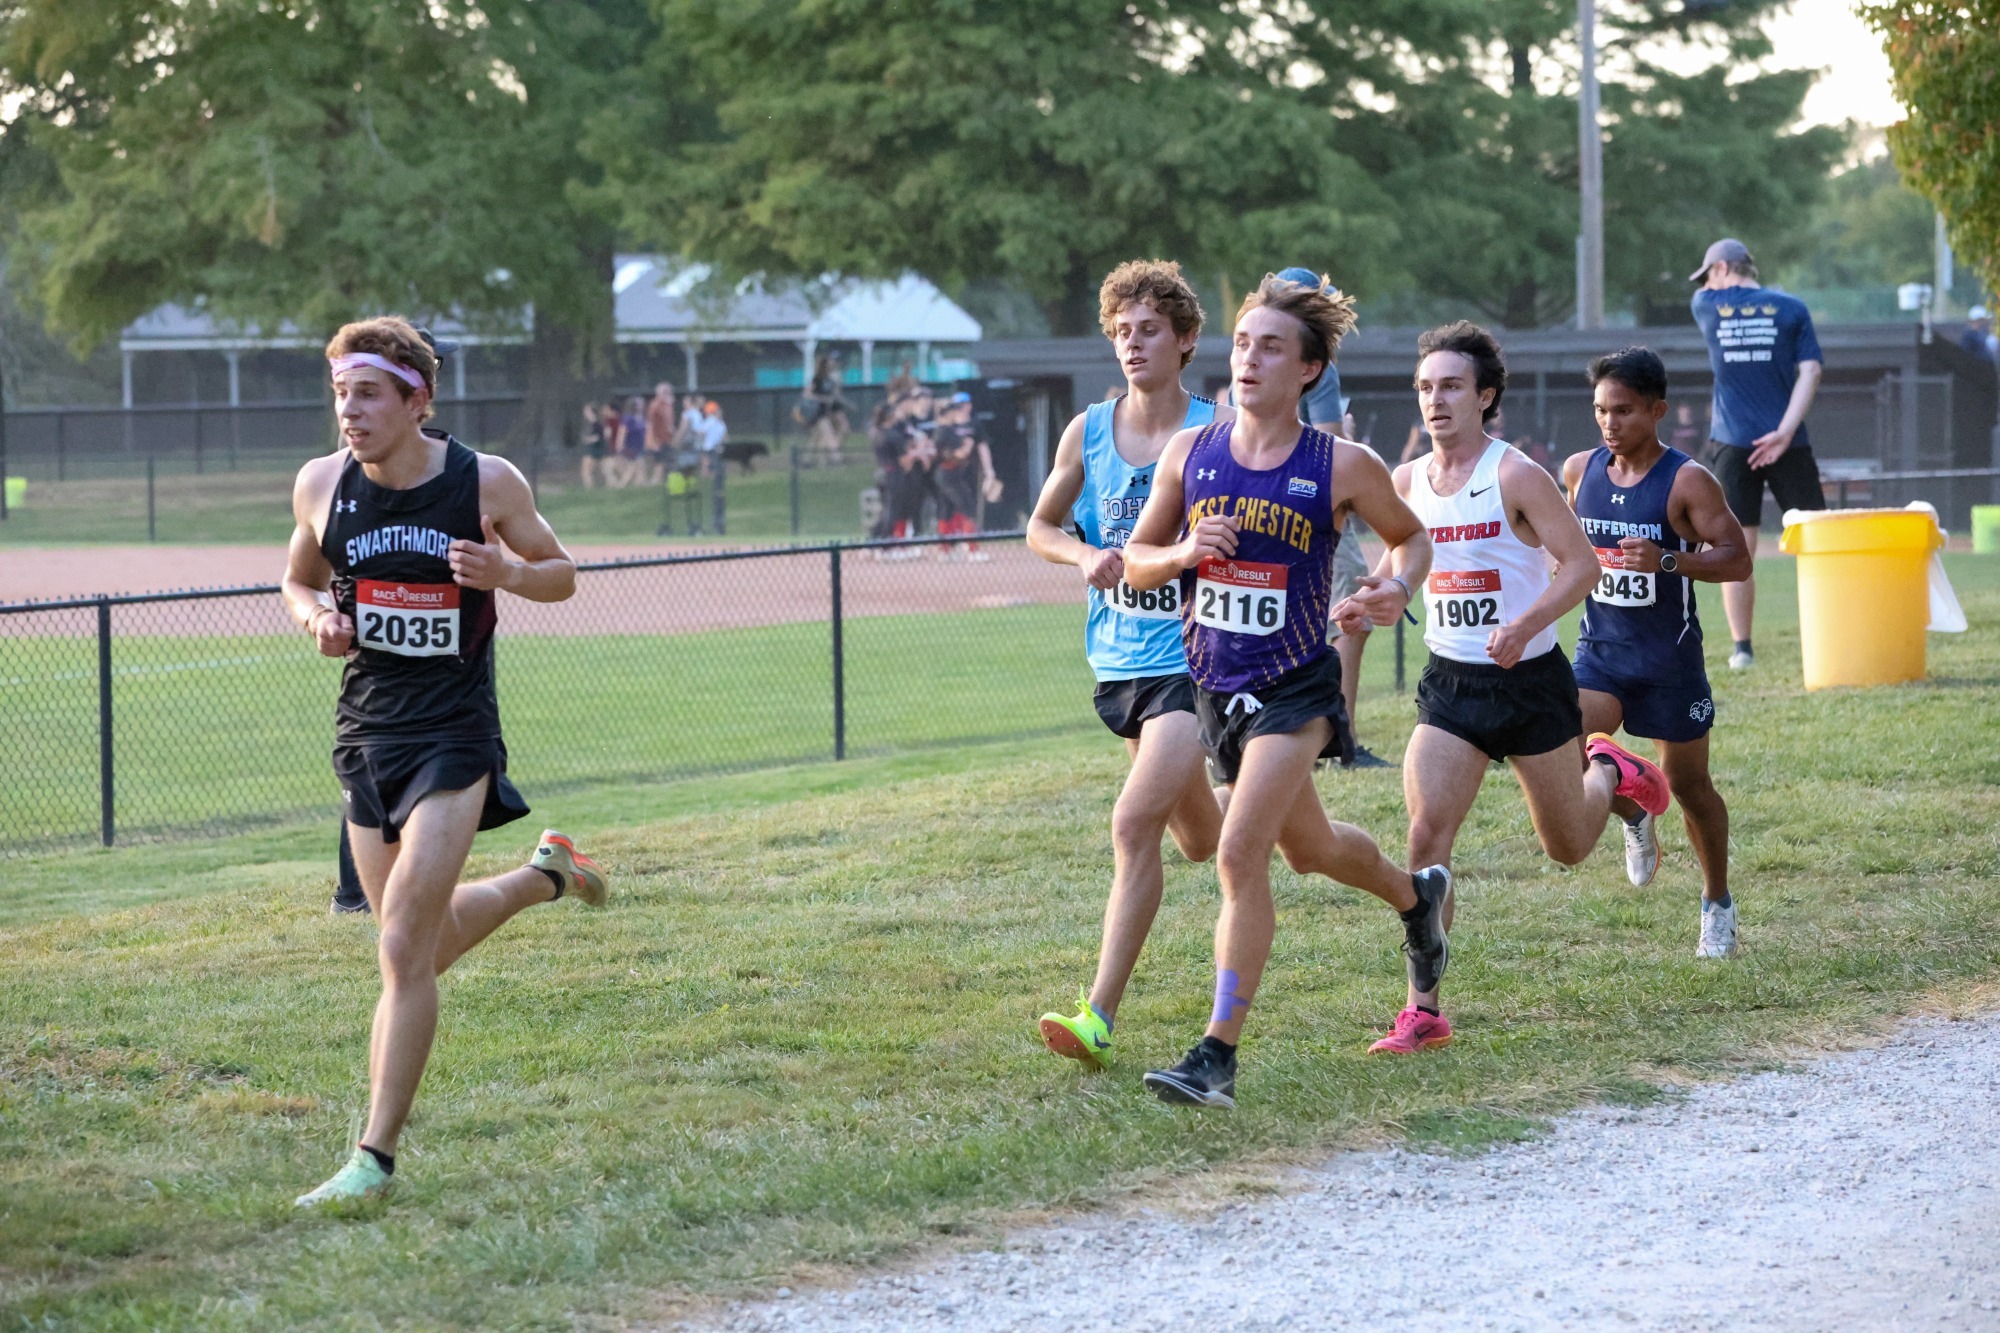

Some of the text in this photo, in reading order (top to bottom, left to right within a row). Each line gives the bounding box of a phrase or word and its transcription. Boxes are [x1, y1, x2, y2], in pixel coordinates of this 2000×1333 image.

[1290, 482, 1317, 494] PSAC
[1103, 496, 1149, 520] JOH
[1234, 497, 1313, 554] CHESTER
[1208, 564, 1227, 577] RACE
[1238, 570, 1271, 581] RESULT
[1436, 578, 1485, 587] RACE RESULT
[372, 589, 444, 602] RACE RESULT
[1112, 582, 1177, 612] 1968
[1200, 587, 1278, 628] 2116
[1435, 598, 1499, 627] 1902
[365, 612, 452, 648] 2035
